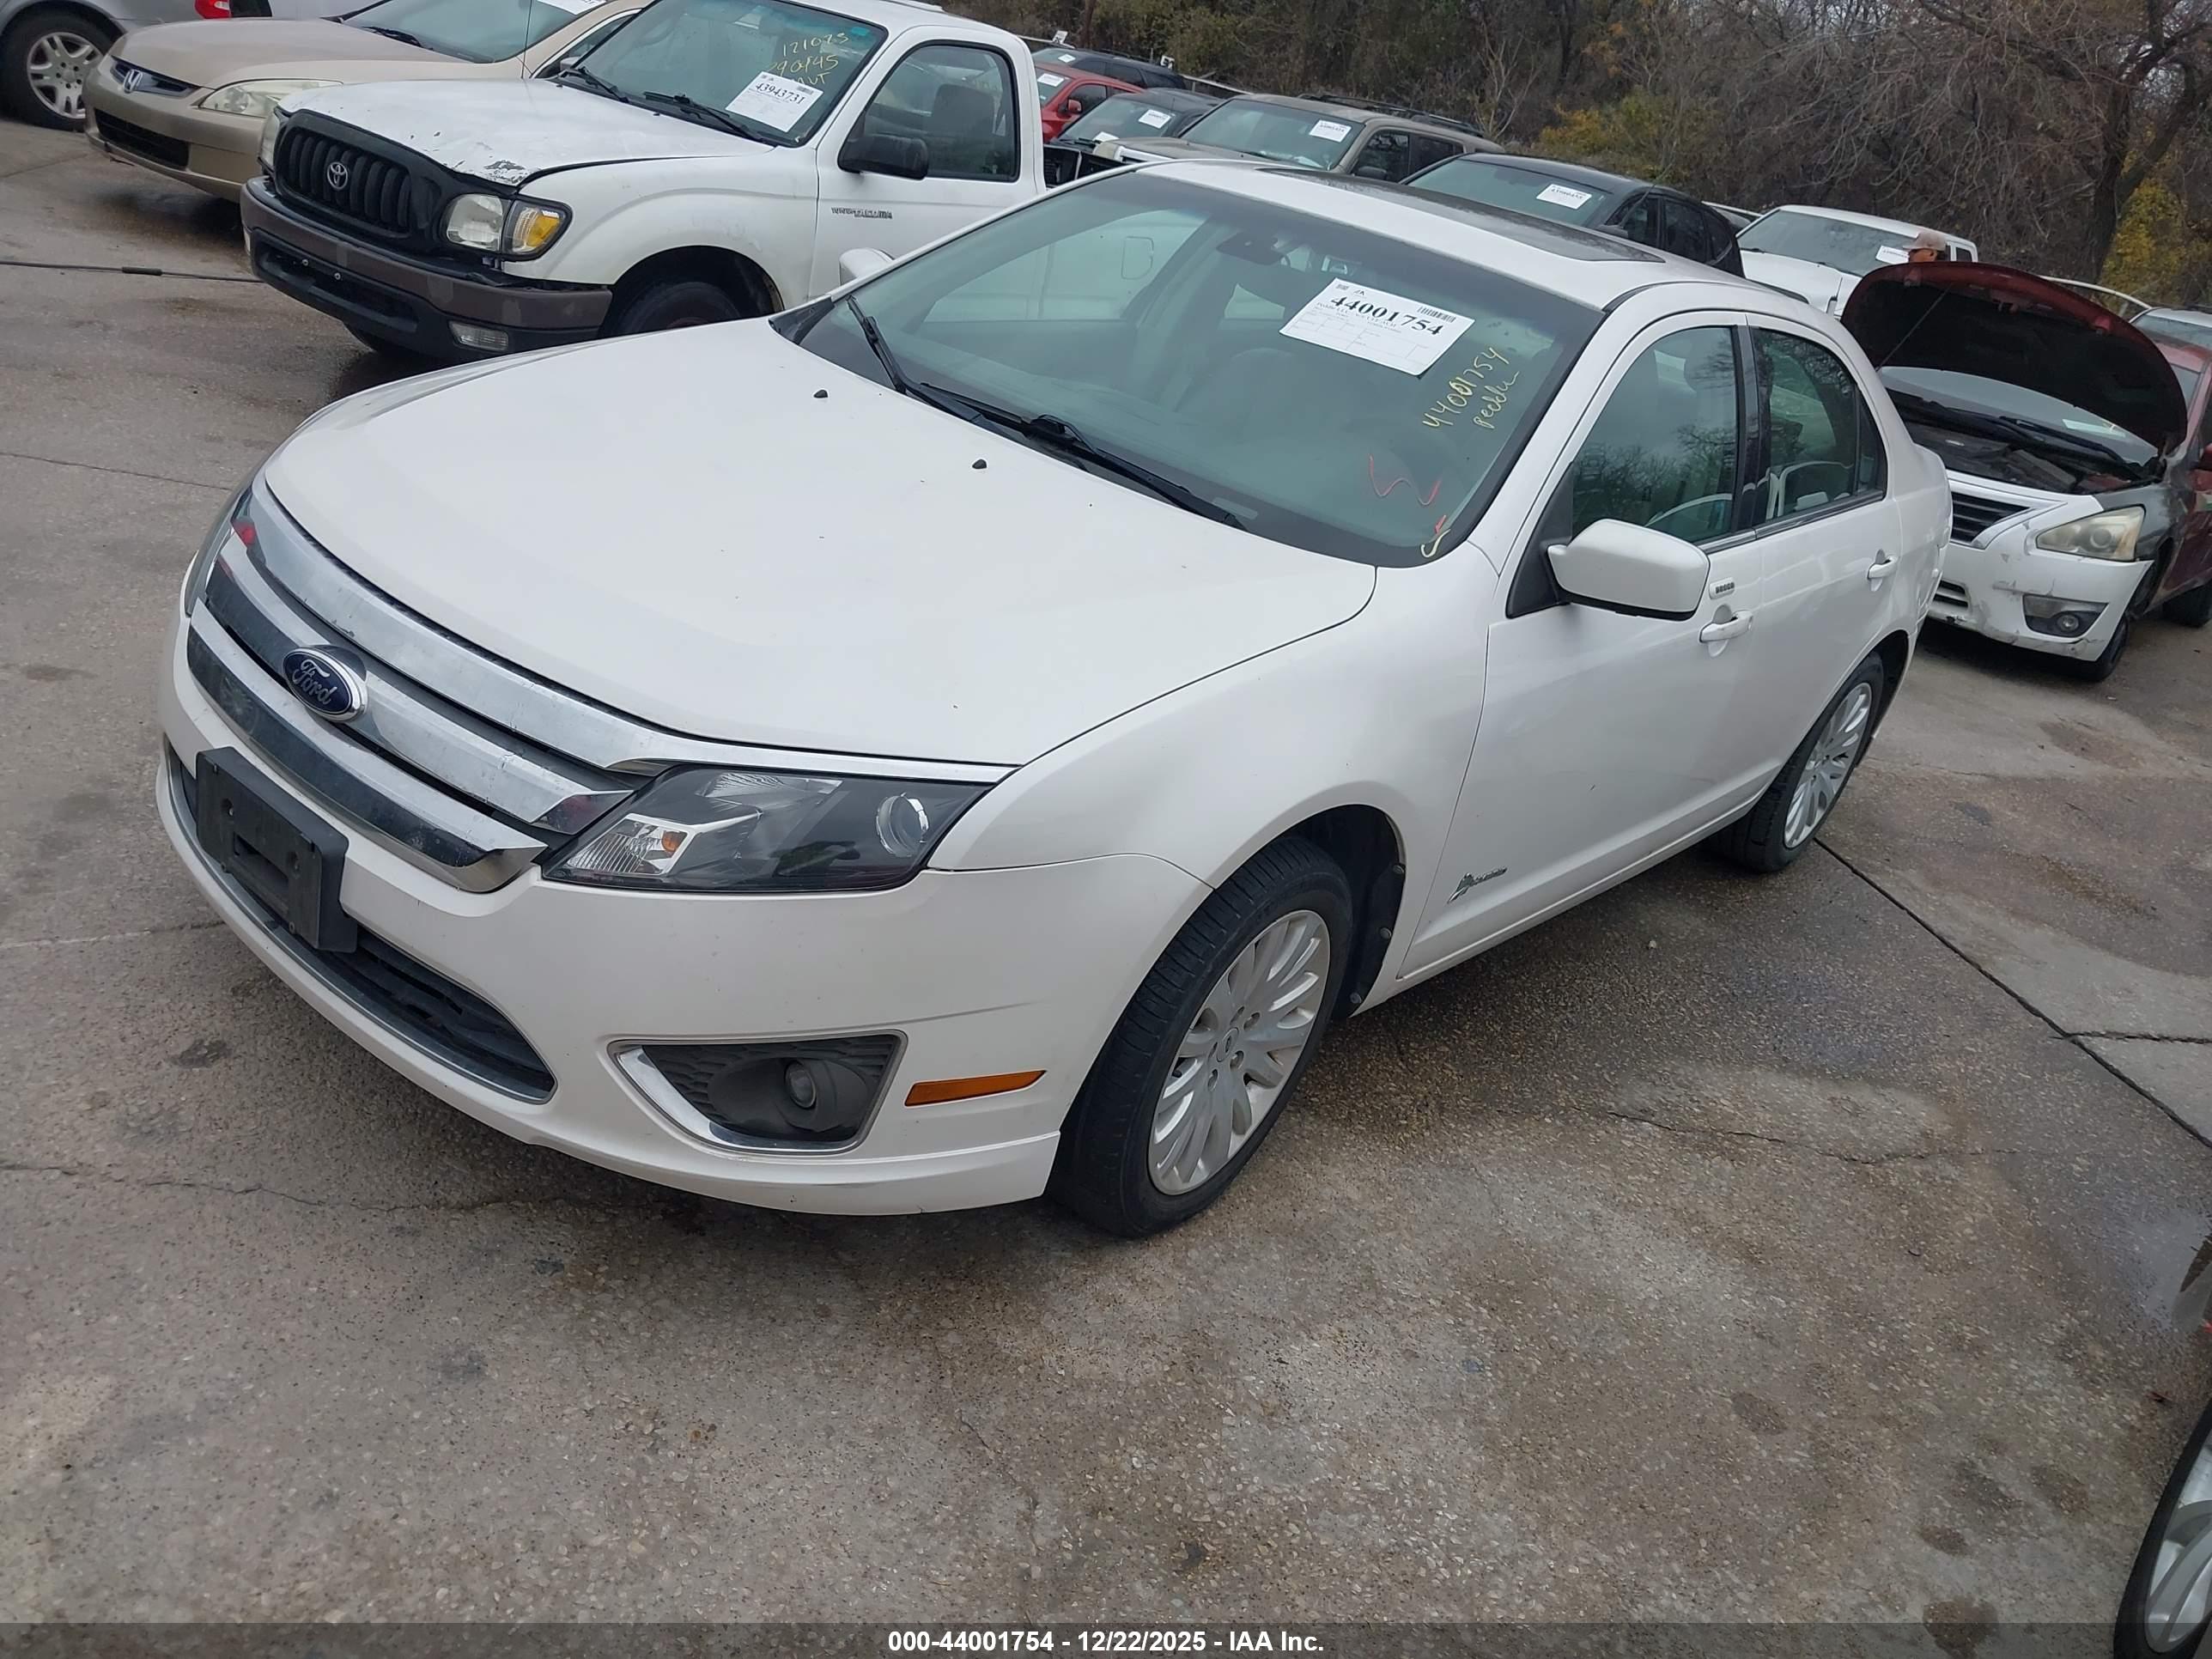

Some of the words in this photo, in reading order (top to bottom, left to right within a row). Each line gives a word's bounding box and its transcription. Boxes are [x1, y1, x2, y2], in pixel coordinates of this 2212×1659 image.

[755, 82, 805, 105] 43943731
[1330, 296, 1444, 336] 44001754
[1422, 347, 1510, 428] 44001754
[292, 659, 337, 705] Ford
